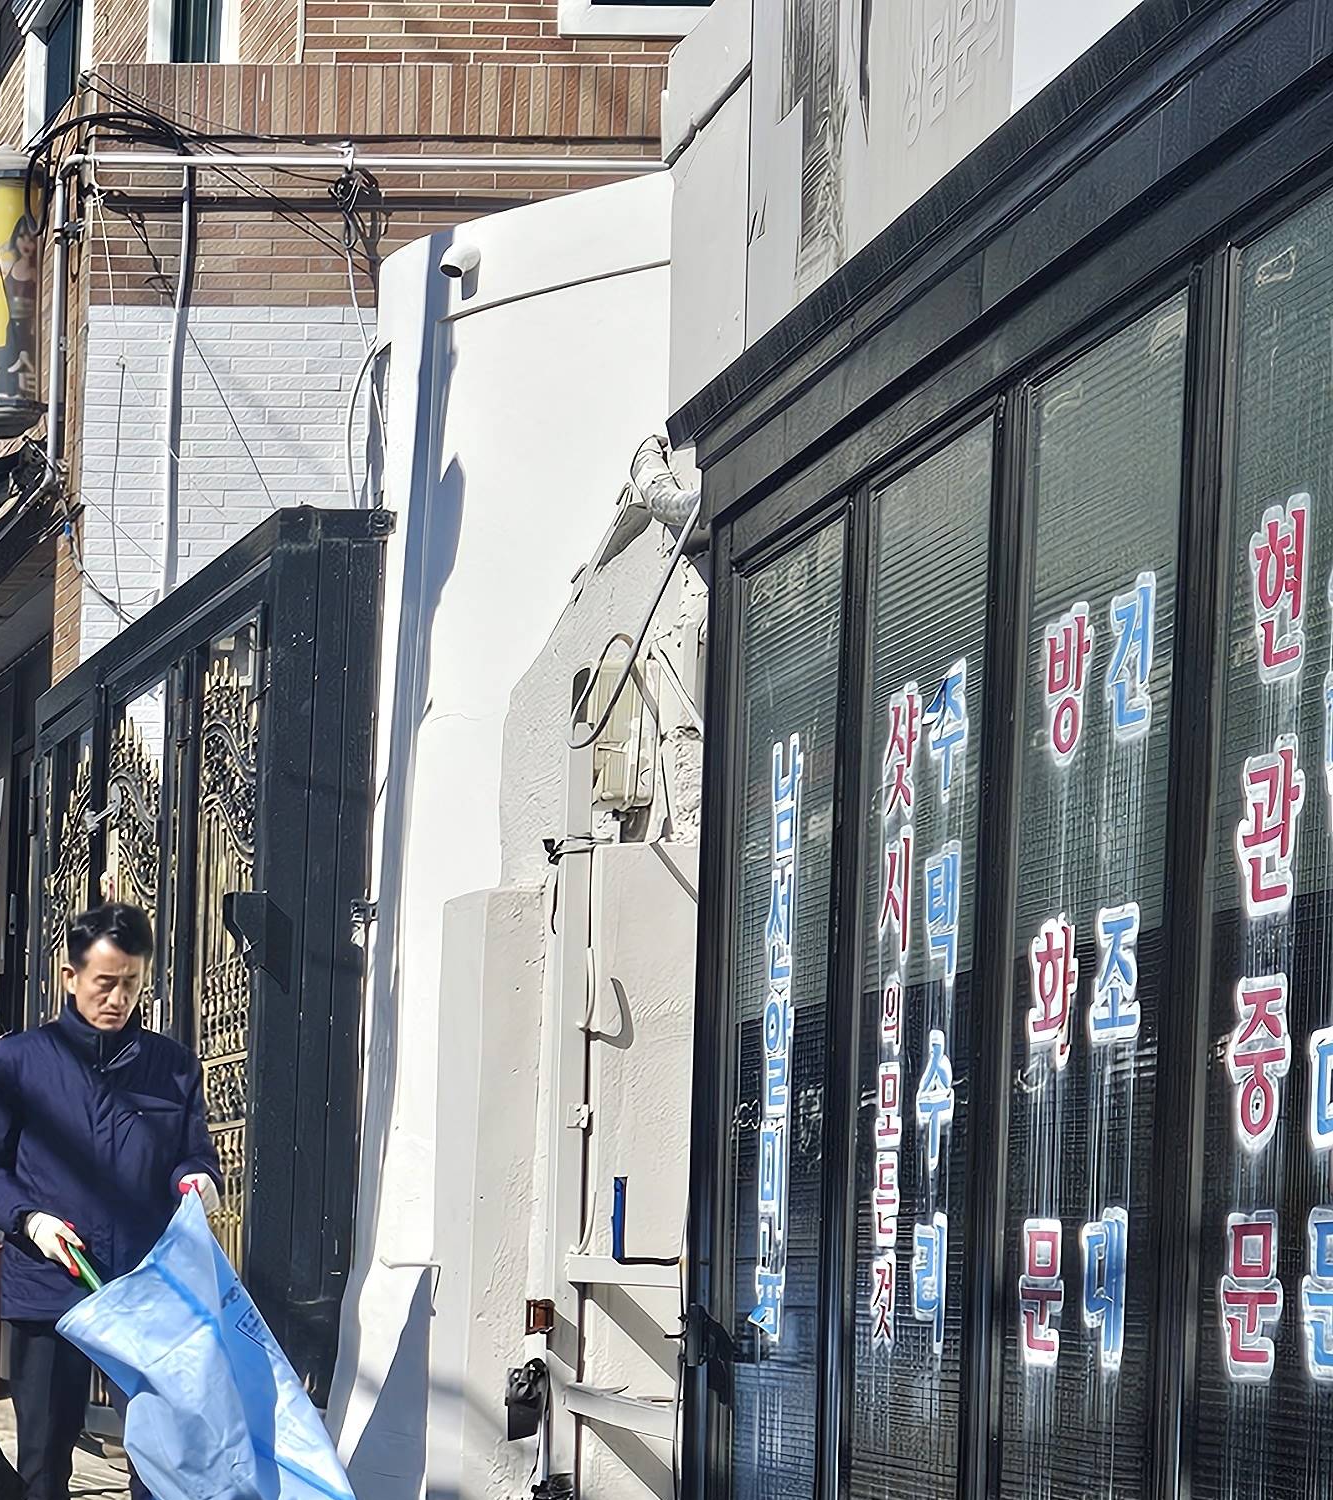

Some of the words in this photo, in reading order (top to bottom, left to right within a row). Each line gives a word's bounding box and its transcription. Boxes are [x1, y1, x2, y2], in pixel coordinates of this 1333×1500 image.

[912, 665, 967, 1346] 주택수리
[1019, 614, 1092, 1363] 방화문
[1221, 507, 1306, 1364] 현관중문
